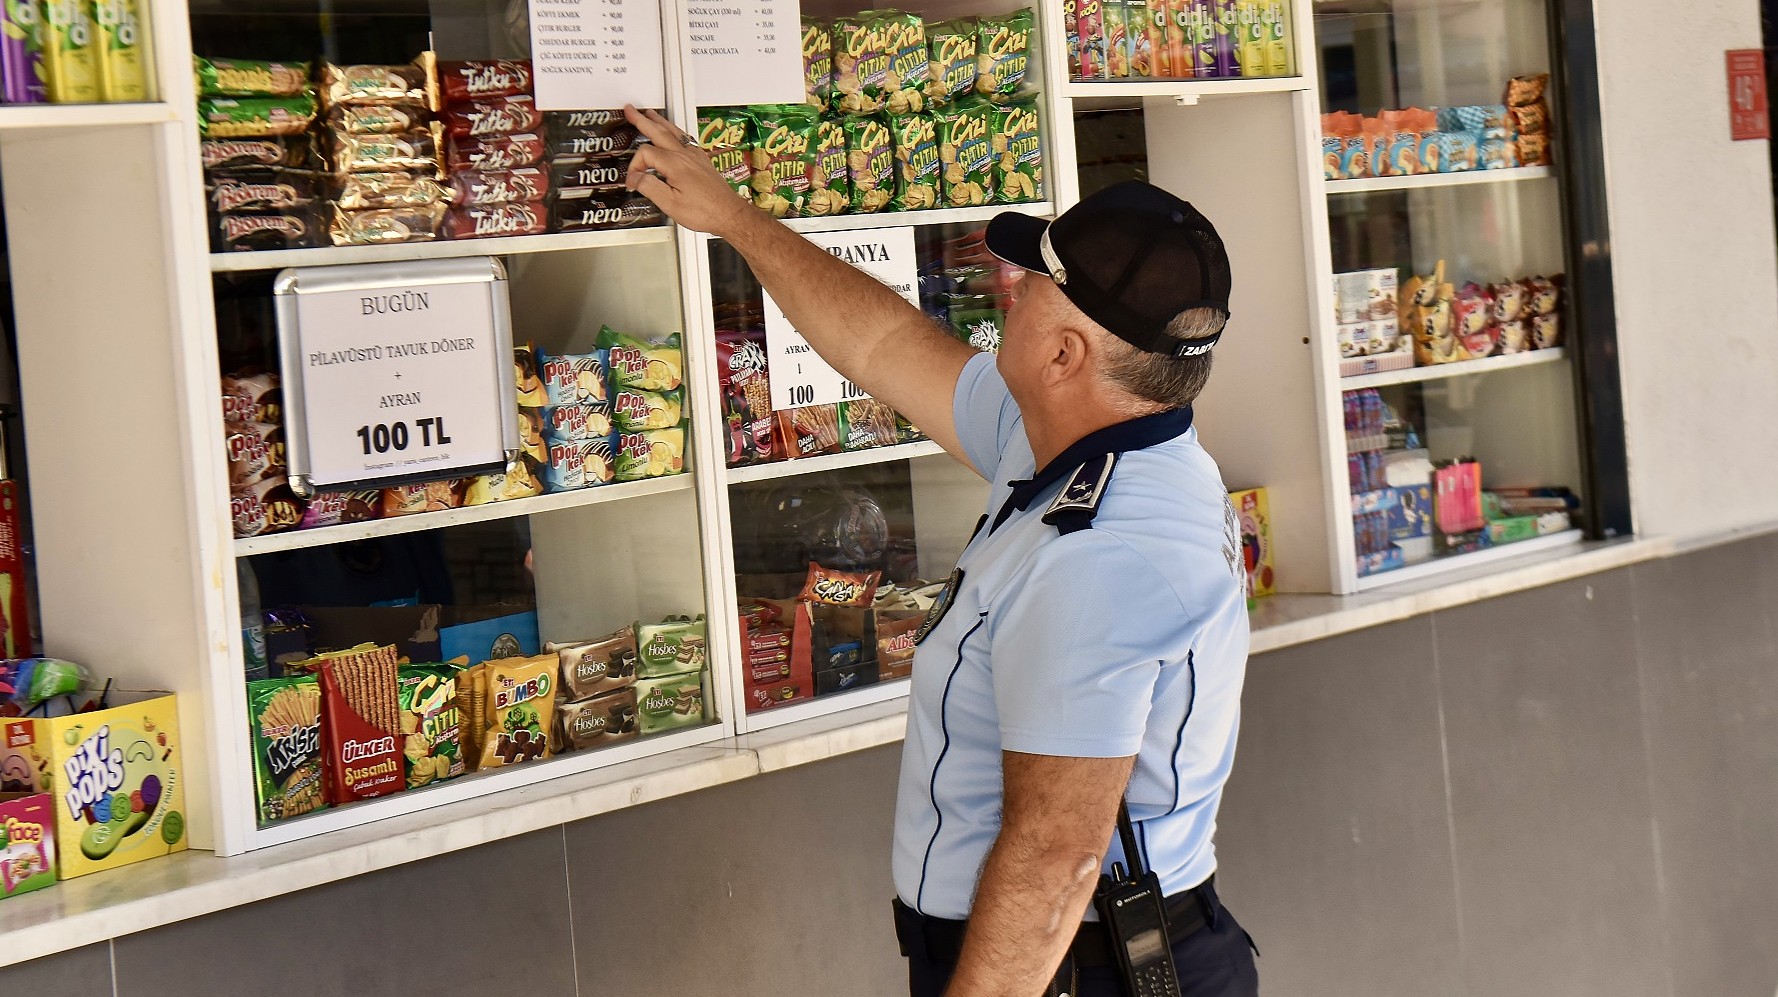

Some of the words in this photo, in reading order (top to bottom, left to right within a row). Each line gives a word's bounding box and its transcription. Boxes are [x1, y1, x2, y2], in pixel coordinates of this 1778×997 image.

[460, 67, 510, 92] Tutku
[468, 111, 514, 136] Tutku
[567, 109, 610, 127] nero
[572, 136, 614, 153] nero
[578, 168, 619, 185] nero
[470, 210, 517, 235] Tutku
[582, 208, 623, 225] nero
[360, 290, 430, 316] BUGÜN
[309, 345, 383, 367] PİLAVÜSTÜ
[385, 341, 429, 359] TAVUK
[431, 337, 476, 355] DÖNER
[609, 347, 641, 368] Pop
[784, 345, 811, 355] AYRAN
[544, 361, 572, 385] Pop
[379, 392, 422, 409] AYRAN
[616, 392, 645, 413] Pop
[788, 384, 814, 406] 100
[553, 405, 581, 431] Pop
[357, 421, 409, 455] 100
[415, 416, 452, 448] TL
[551, 444, 579, 469] Pop
[496, 671, 551, 710] BUMBO
[64, 724, 111, 785] pixi
[342, 736, 396, 764] ÜLKER
[65, 747, 126, 822] pops
[345, 757, 398, 787] Susamlı
